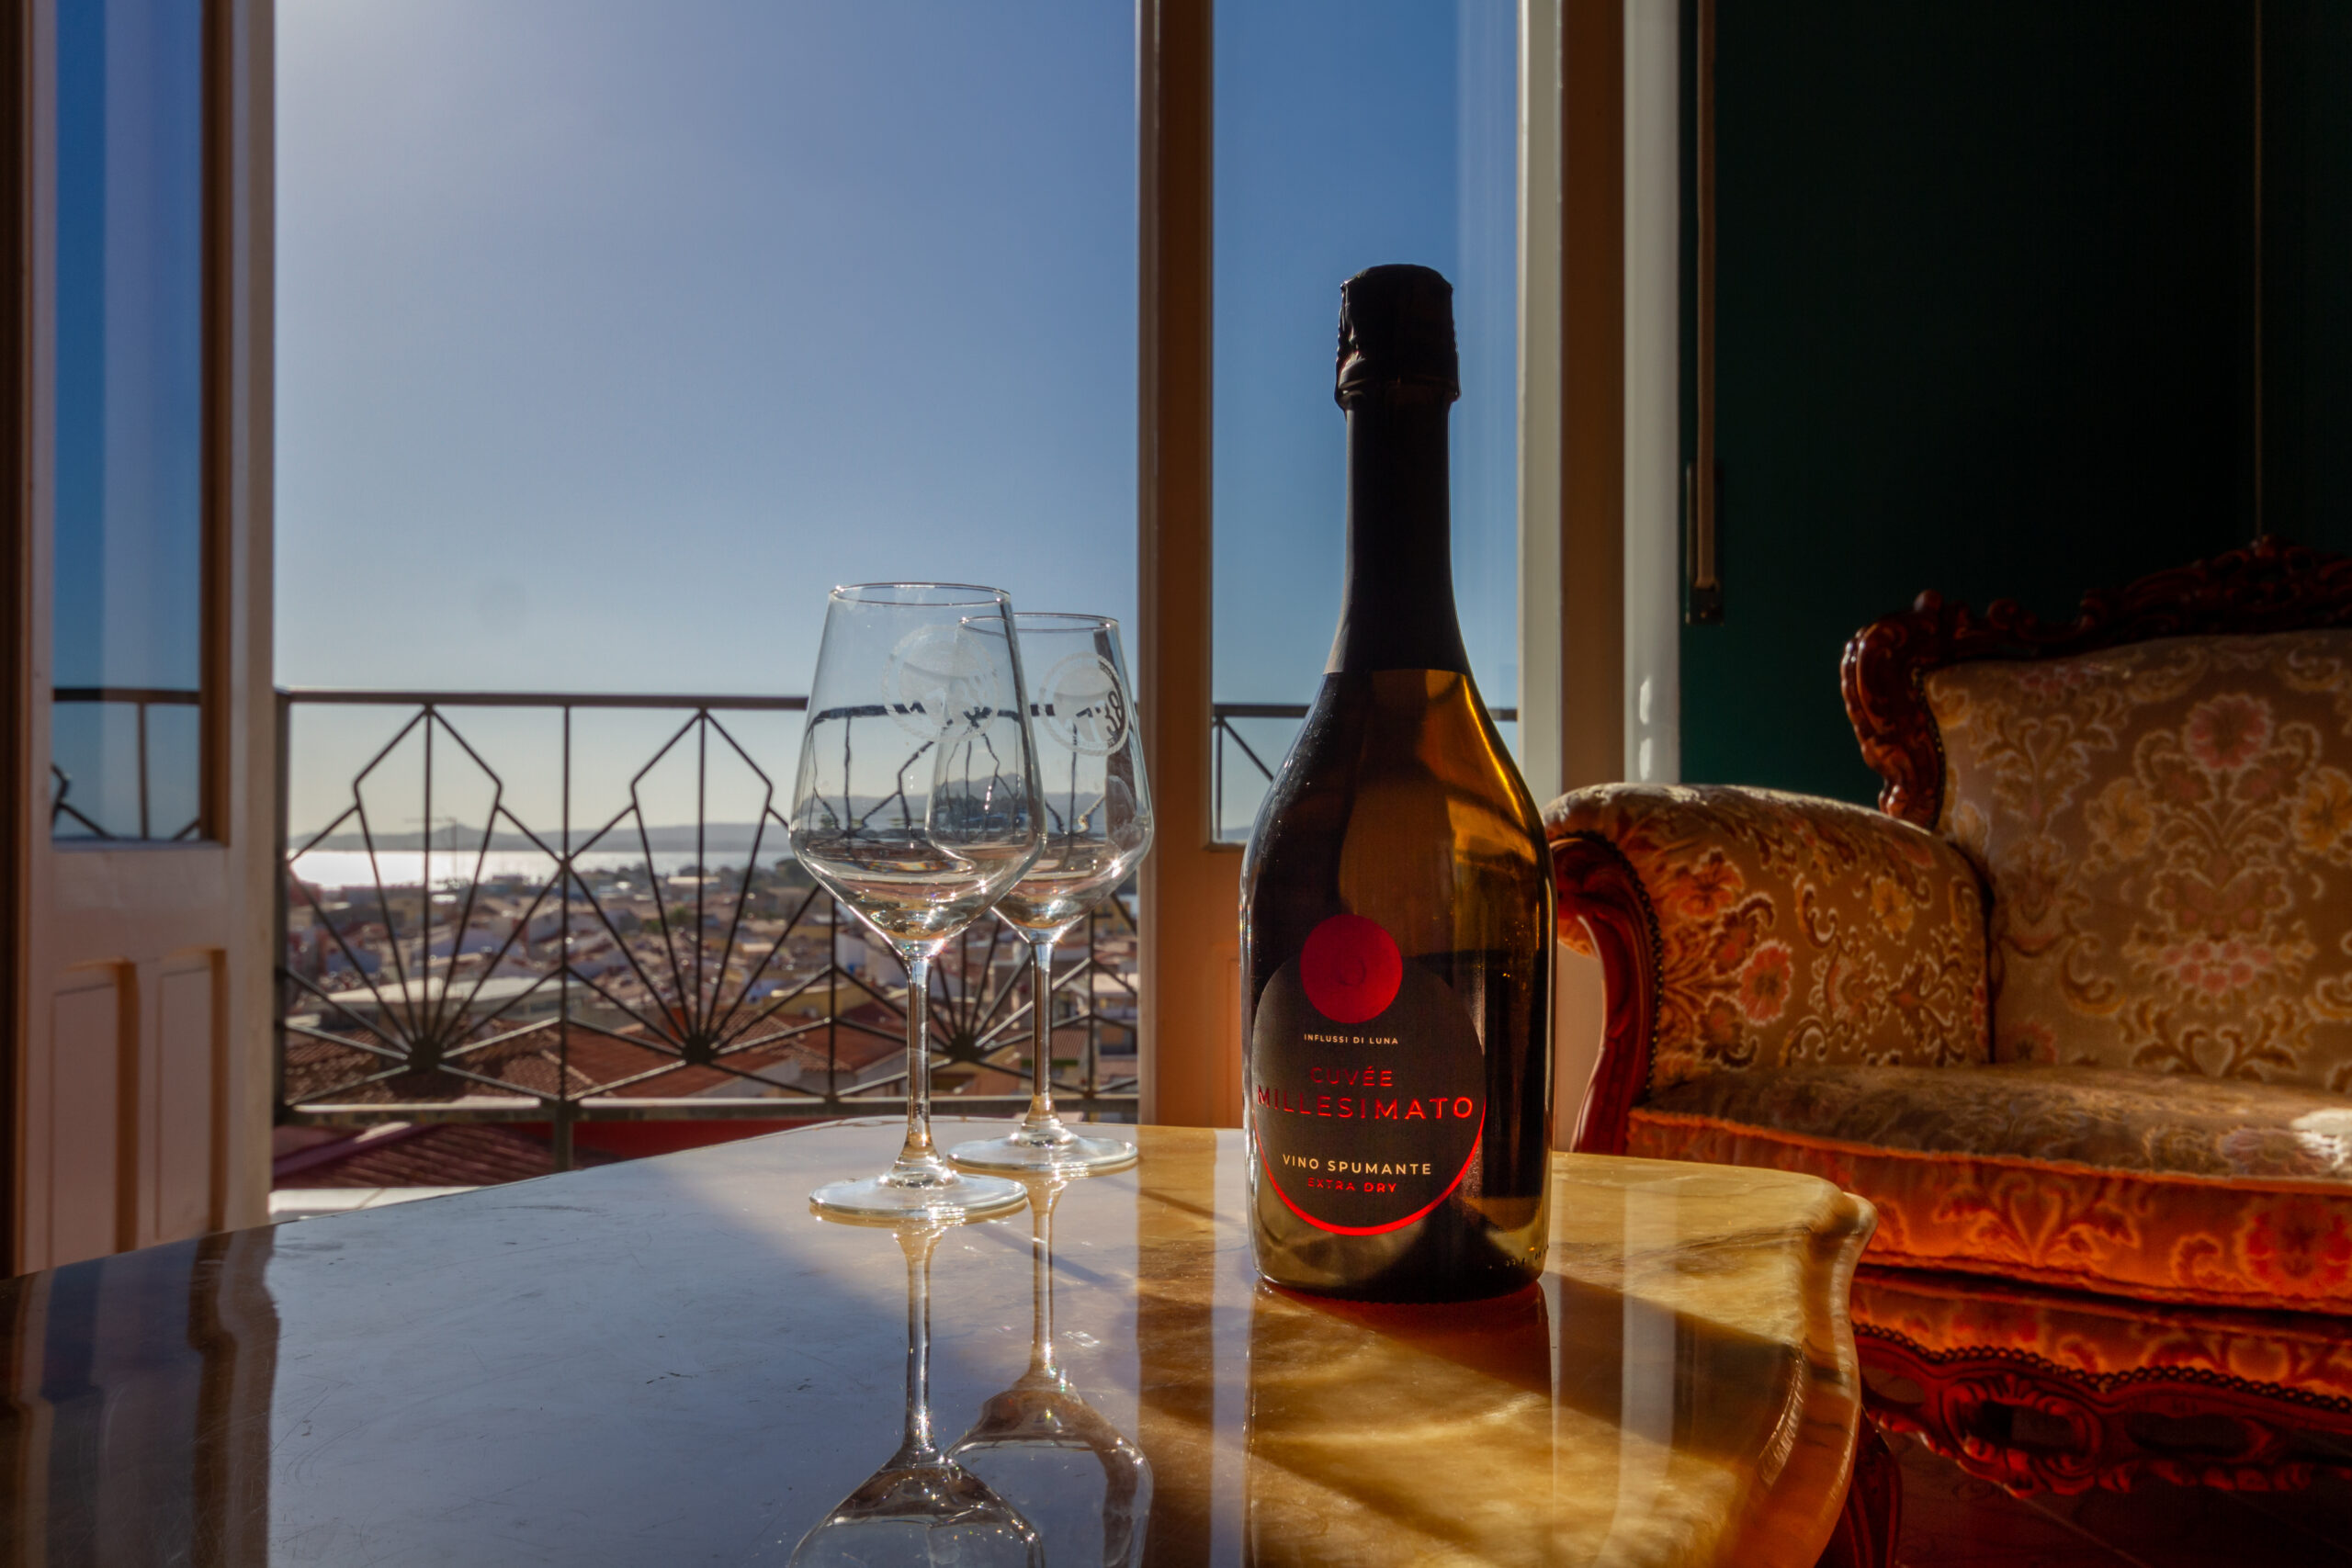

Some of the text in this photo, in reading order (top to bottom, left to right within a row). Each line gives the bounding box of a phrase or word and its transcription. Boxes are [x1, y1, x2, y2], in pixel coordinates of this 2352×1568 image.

[1304, 1033, 1398, 1045] INFLUSSI DI LUNA
[1310, 1066, 1394, 1087] CUVÉE
[1257, 1084, 1474, 1120] MILLESIMATO
[1283, 1153, 1431, 1176] VINO SPUMANTE
[1307, 1177, 1396, 1193] EXTRA DRY
